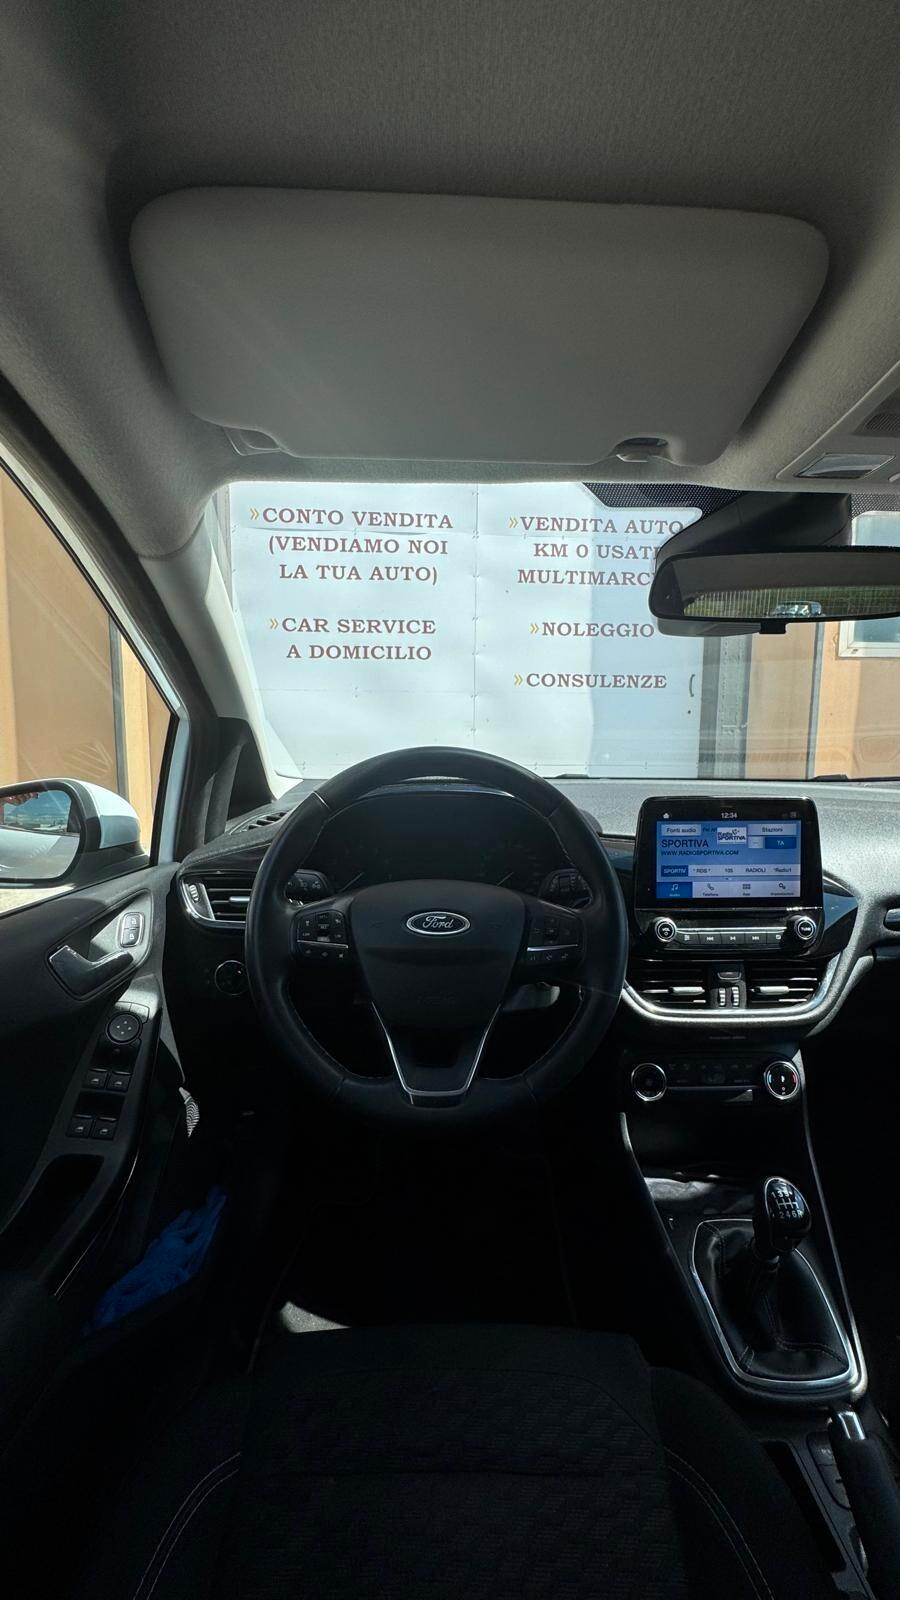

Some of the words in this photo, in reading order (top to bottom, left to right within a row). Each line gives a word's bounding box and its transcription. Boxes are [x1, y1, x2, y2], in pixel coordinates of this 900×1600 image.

[262, 507, 344, 525] CONTO
[352, 511, 453, 529] VENDITA
[520, 516, 618, 533] VENDITA
[624, 519, 684, 535] AUTO
[269, 535, 400, 555] (VENDIAMO
[408, 539, 449, 555] NOI
[533, 543, 568, 558] KM
[279, 563, 308, 579] LA
[316, 564, 361, 581] TUA
[369, 566, 438, 586] AUTO)
[517, 569, 655, 586] MULTIMARC
[282, 617, 330, 633] CAR
[337, 619, 436, 635] SERVICE
[542, 622, 655, 638] NOLEGGIO
[286, 644, 301, 659] A
[309, 644, 432, 661] DOMICILIO
[526, 673, 667, 689] CONSULENZE
[661, 839, 709, 848] SPORTIVA
[422, 915, 454, 930] Ford
